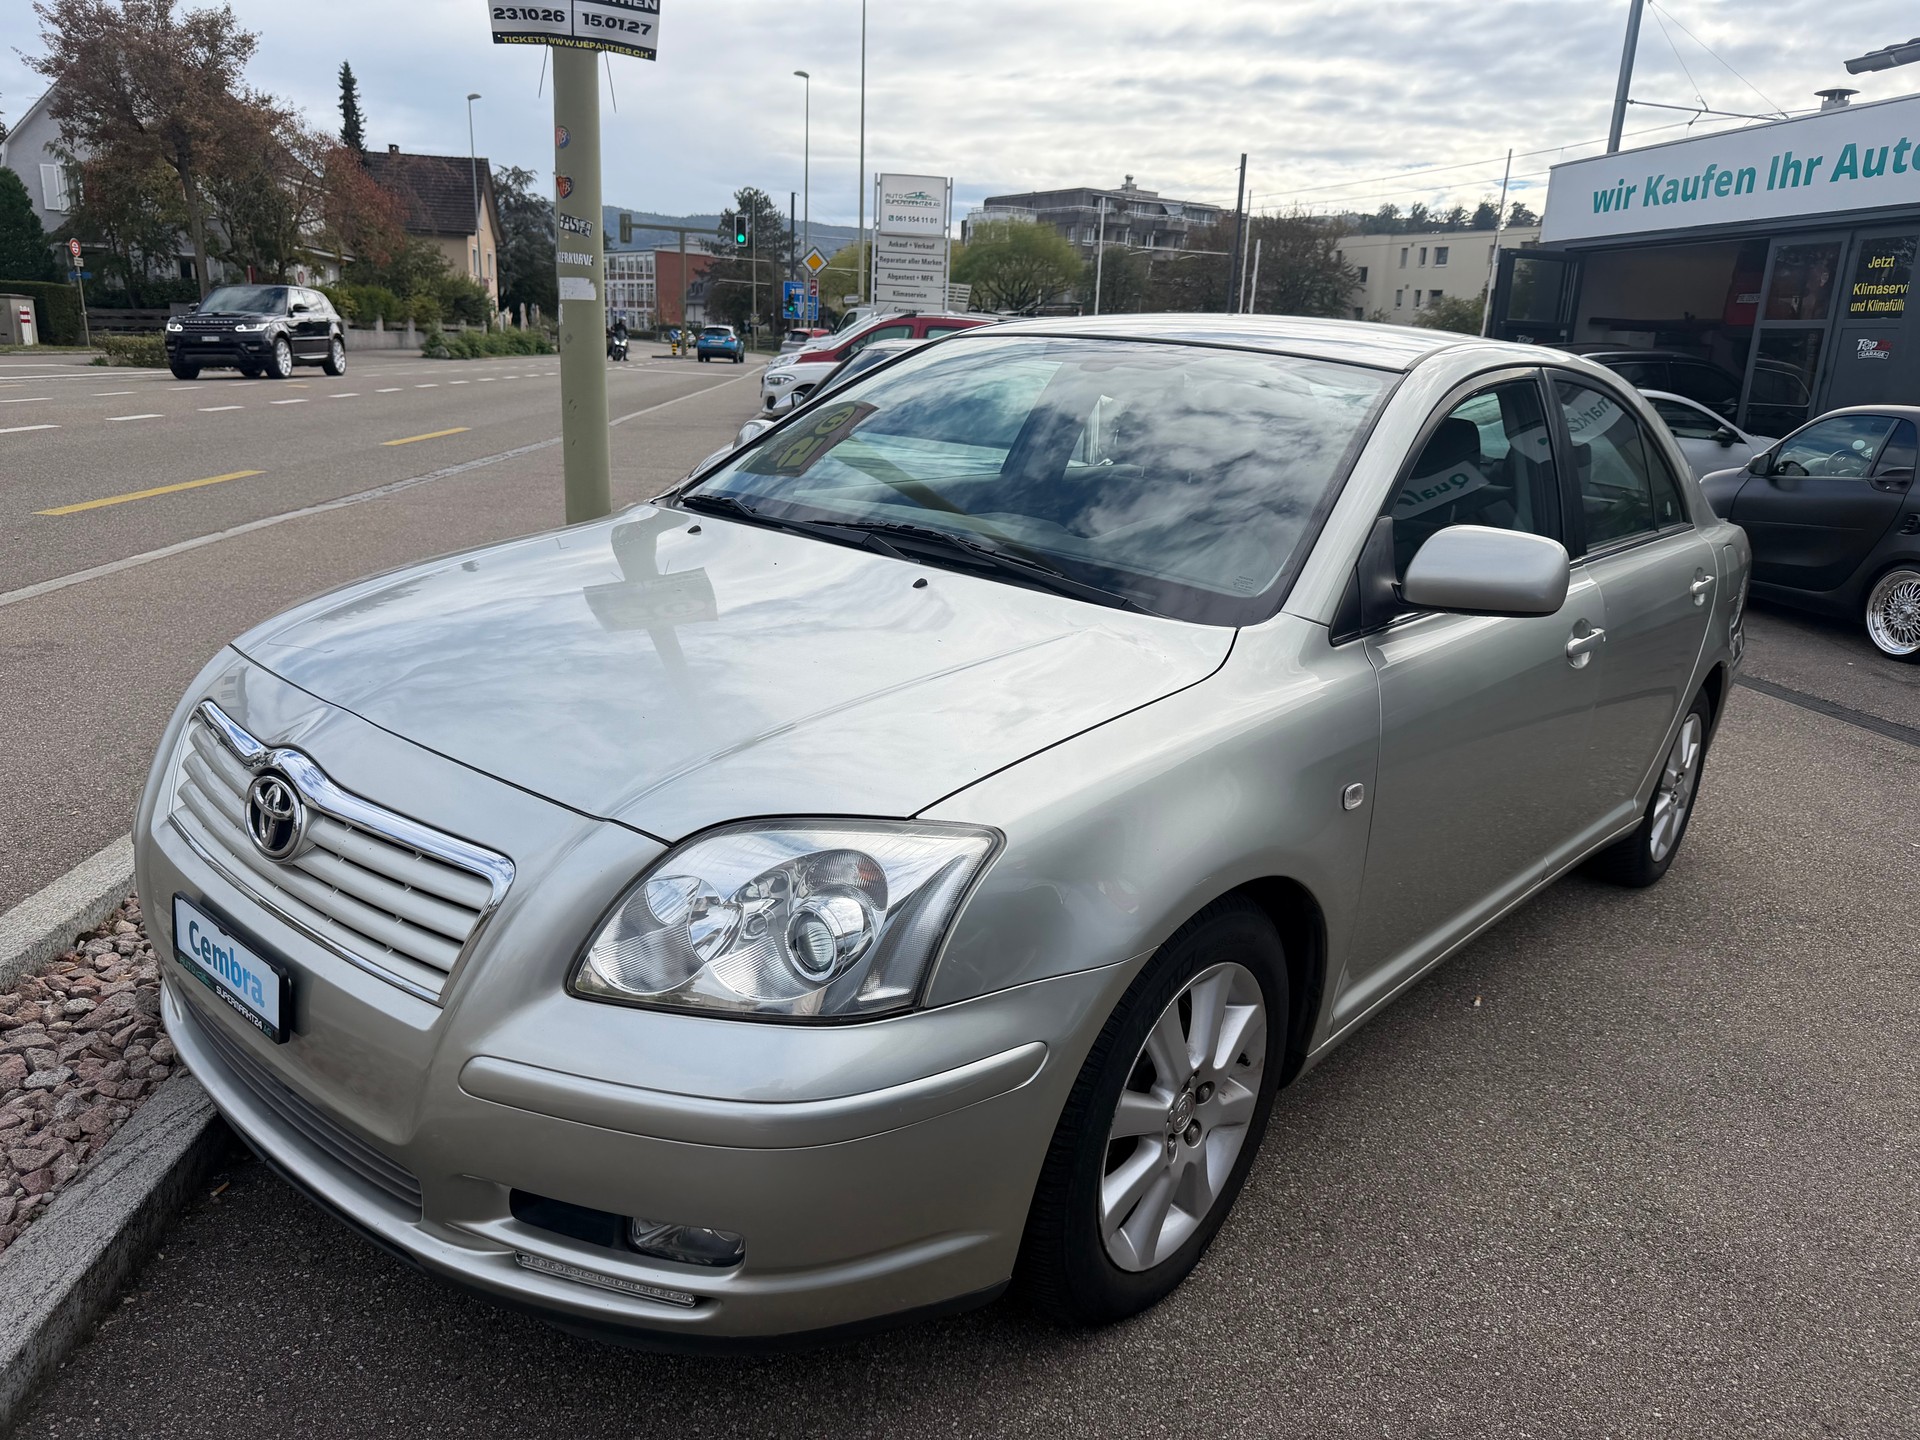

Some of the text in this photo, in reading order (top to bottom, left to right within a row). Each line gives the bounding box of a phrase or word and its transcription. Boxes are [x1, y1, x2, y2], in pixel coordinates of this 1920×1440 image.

[492, 8, 652, 36] 23.10.26 15.01.27
[502, 36, 546, 44] TICKETS
[1593, 179, 1637, 214] wir
[1642, 163, 1757, 207] Kaufen
[1767, 151, 1823, 191] Ihr
[913, 242, 935, 250] Verkauf
[879, 256, 907, 264] Reparatur
[921, 258, 942, 266] Marken
[1868, 256, 1895, 268] Jetzt
[887, 272, 915, 281] Abgastest
[893, 290, 927, 298] Klimaservice
[1850, 300, 1865, 312] und
[189, 920, 265, 1008] Cembra
